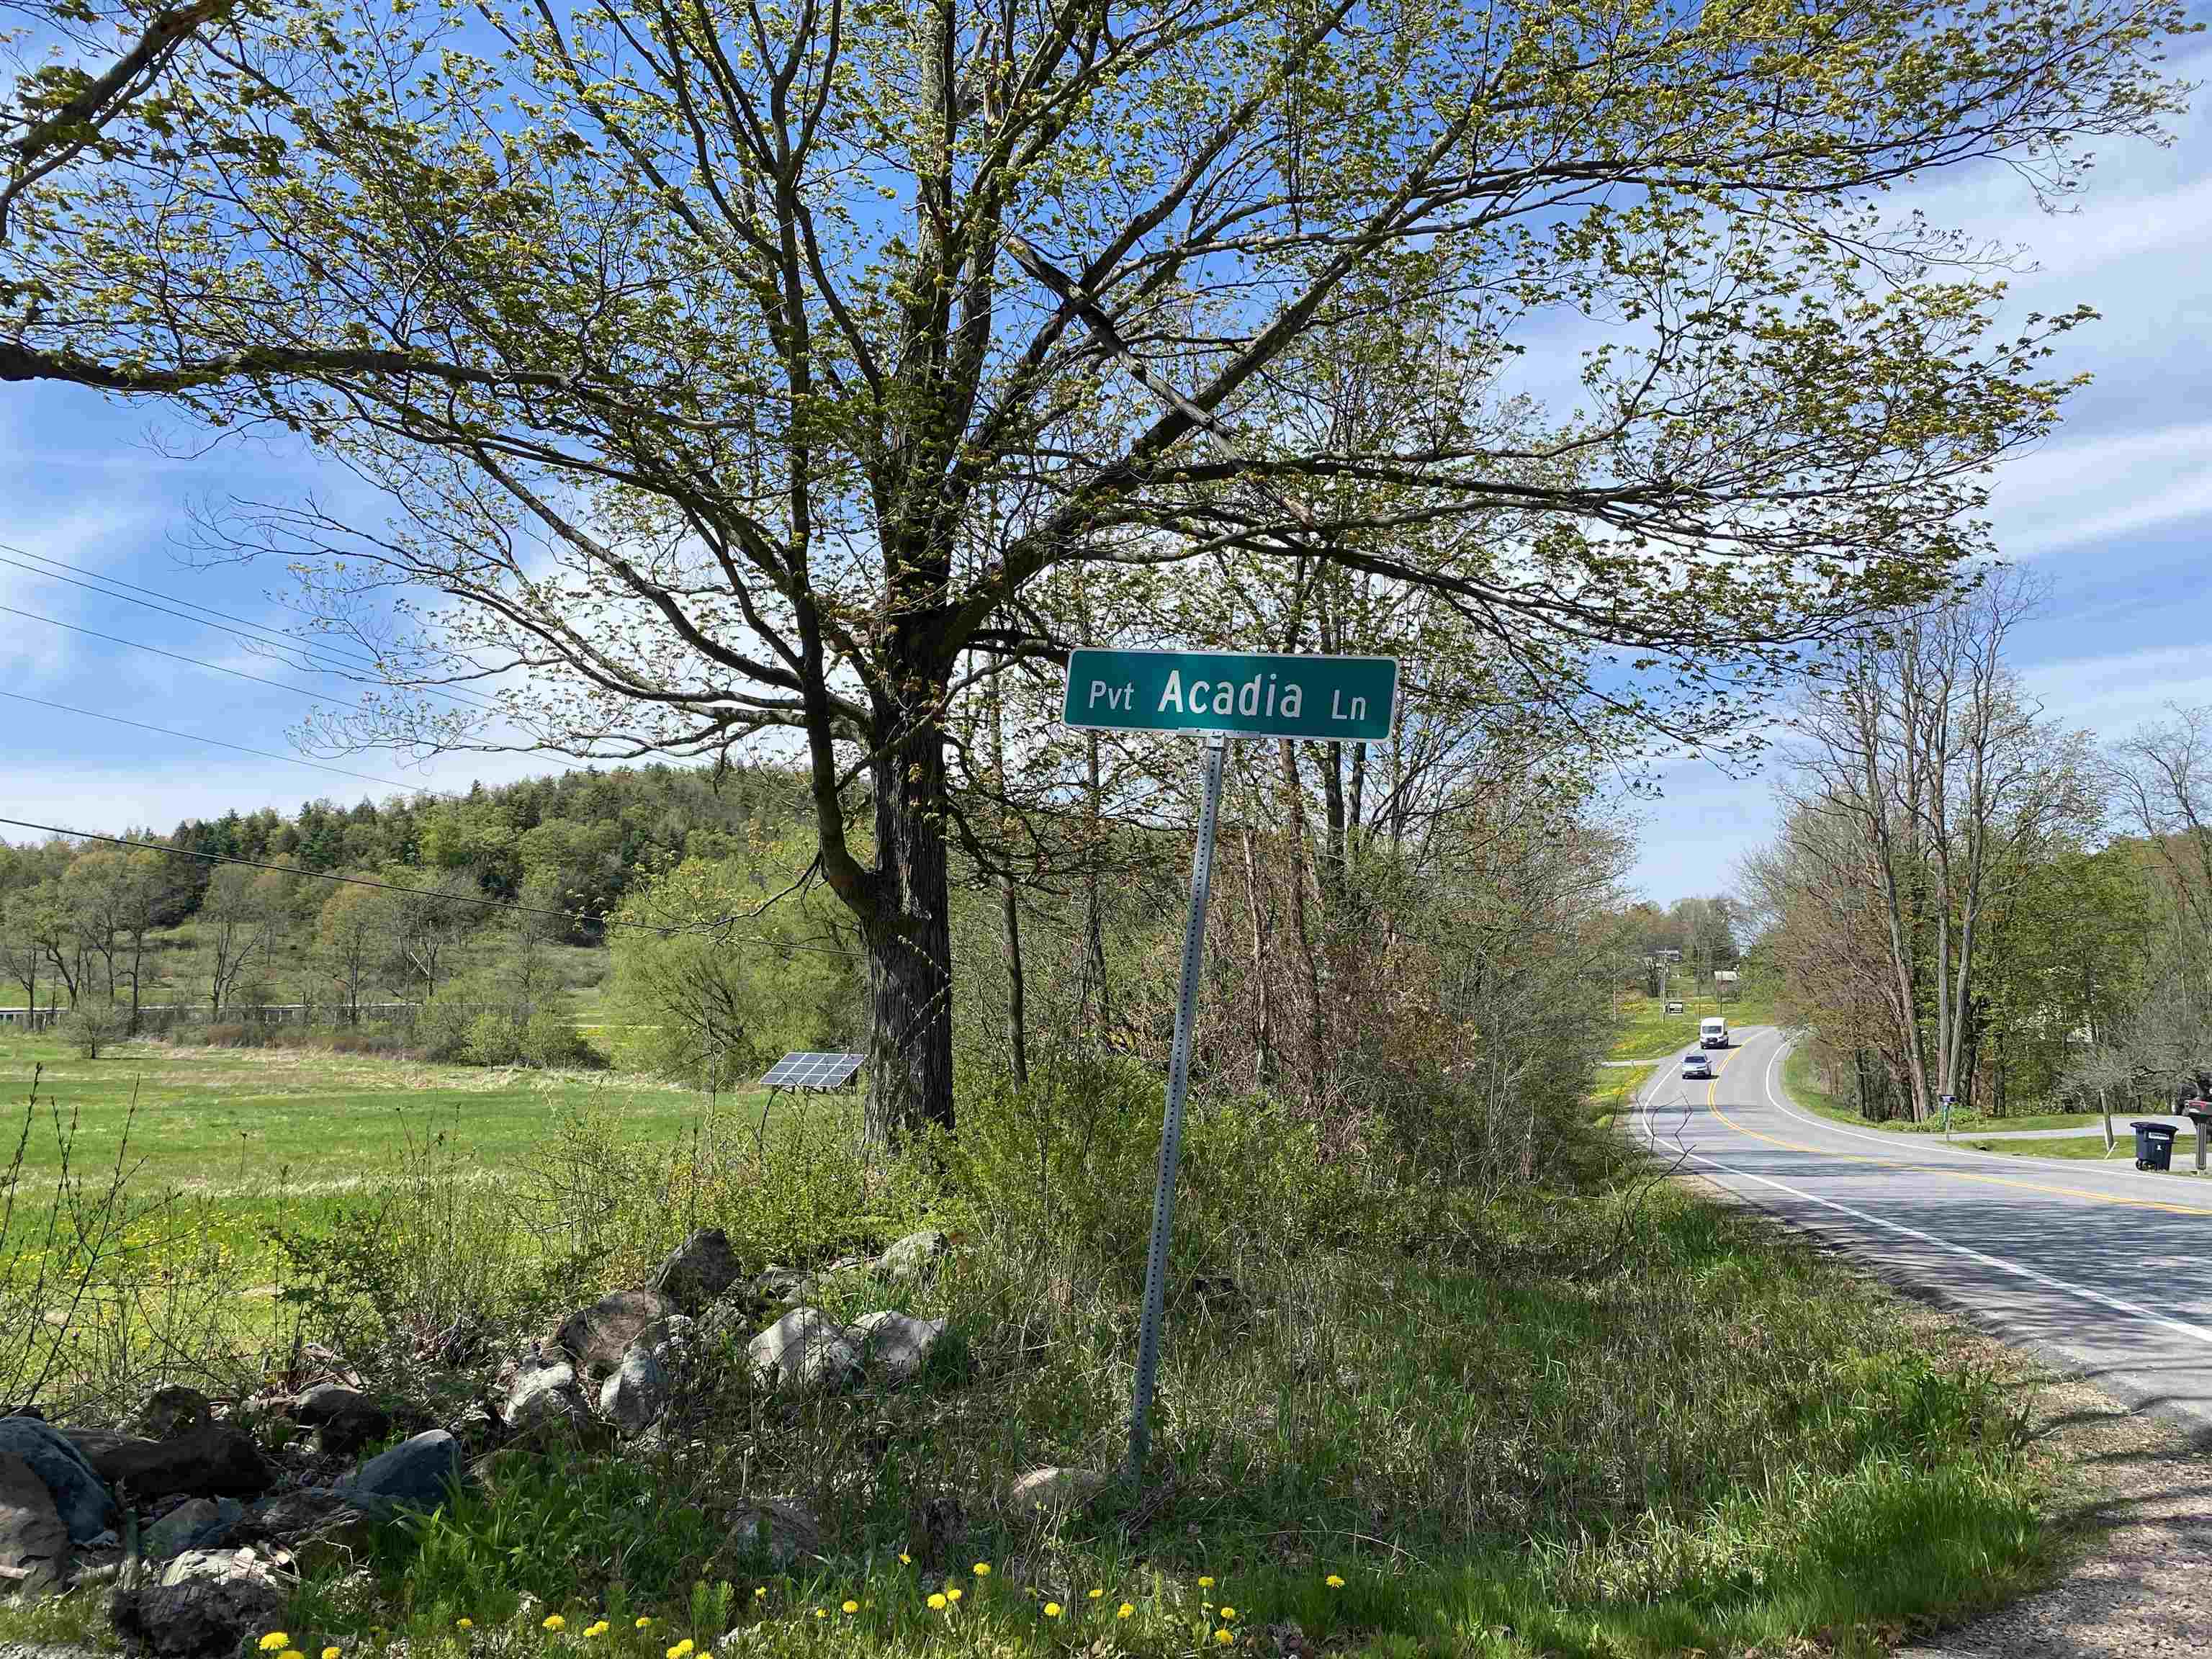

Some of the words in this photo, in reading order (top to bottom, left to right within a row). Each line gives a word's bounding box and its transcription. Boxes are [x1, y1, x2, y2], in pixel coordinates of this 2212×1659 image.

[1089, 680, 1134, 710] Pvt
[1157, 670, 1303, 718] Acadia
[1331, 689, 1366, 721] Ln
